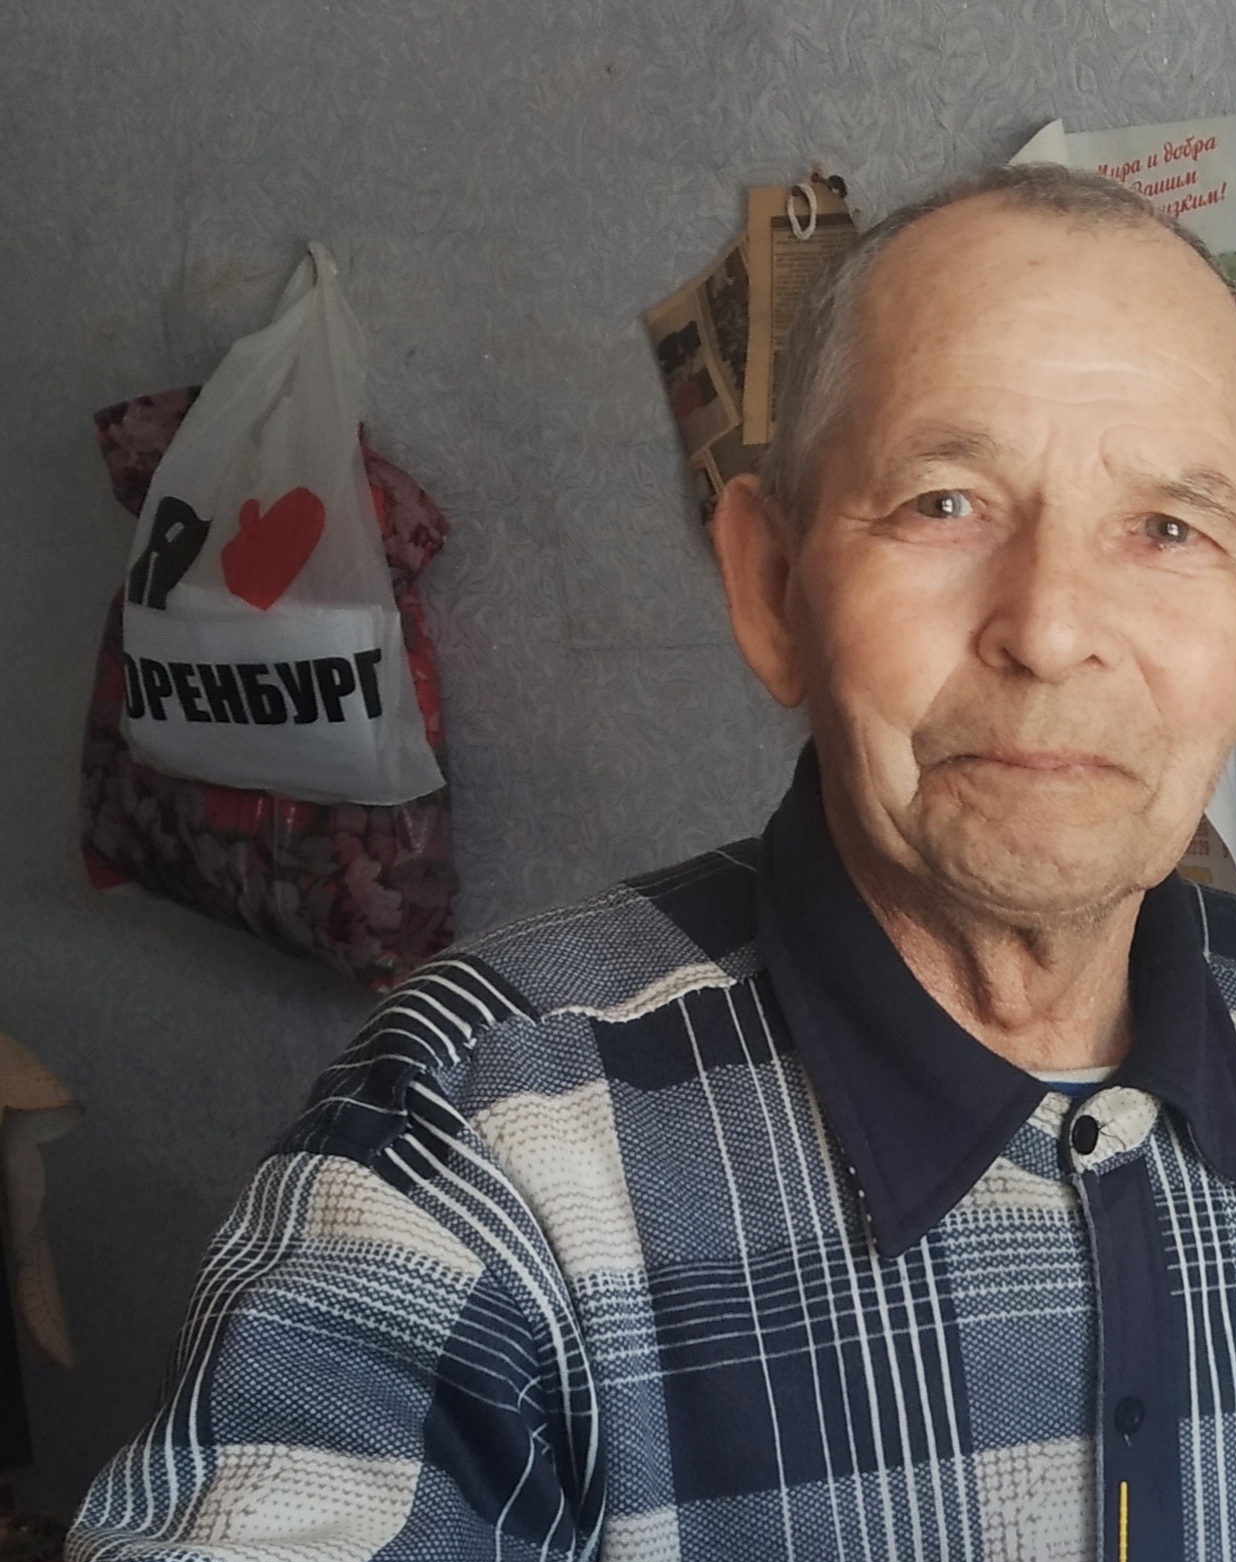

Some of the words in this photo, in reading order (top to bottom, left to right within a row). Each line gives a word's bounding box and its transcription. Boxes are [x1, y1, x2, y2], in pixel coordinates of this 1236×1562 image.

[1146, 154, 1158, 169] и
[1162, 135, 1217, 162] добра
[1163, 181, 1228, 219] изким!
[123, 647, 383, 725] ОРЕНБУРГ
